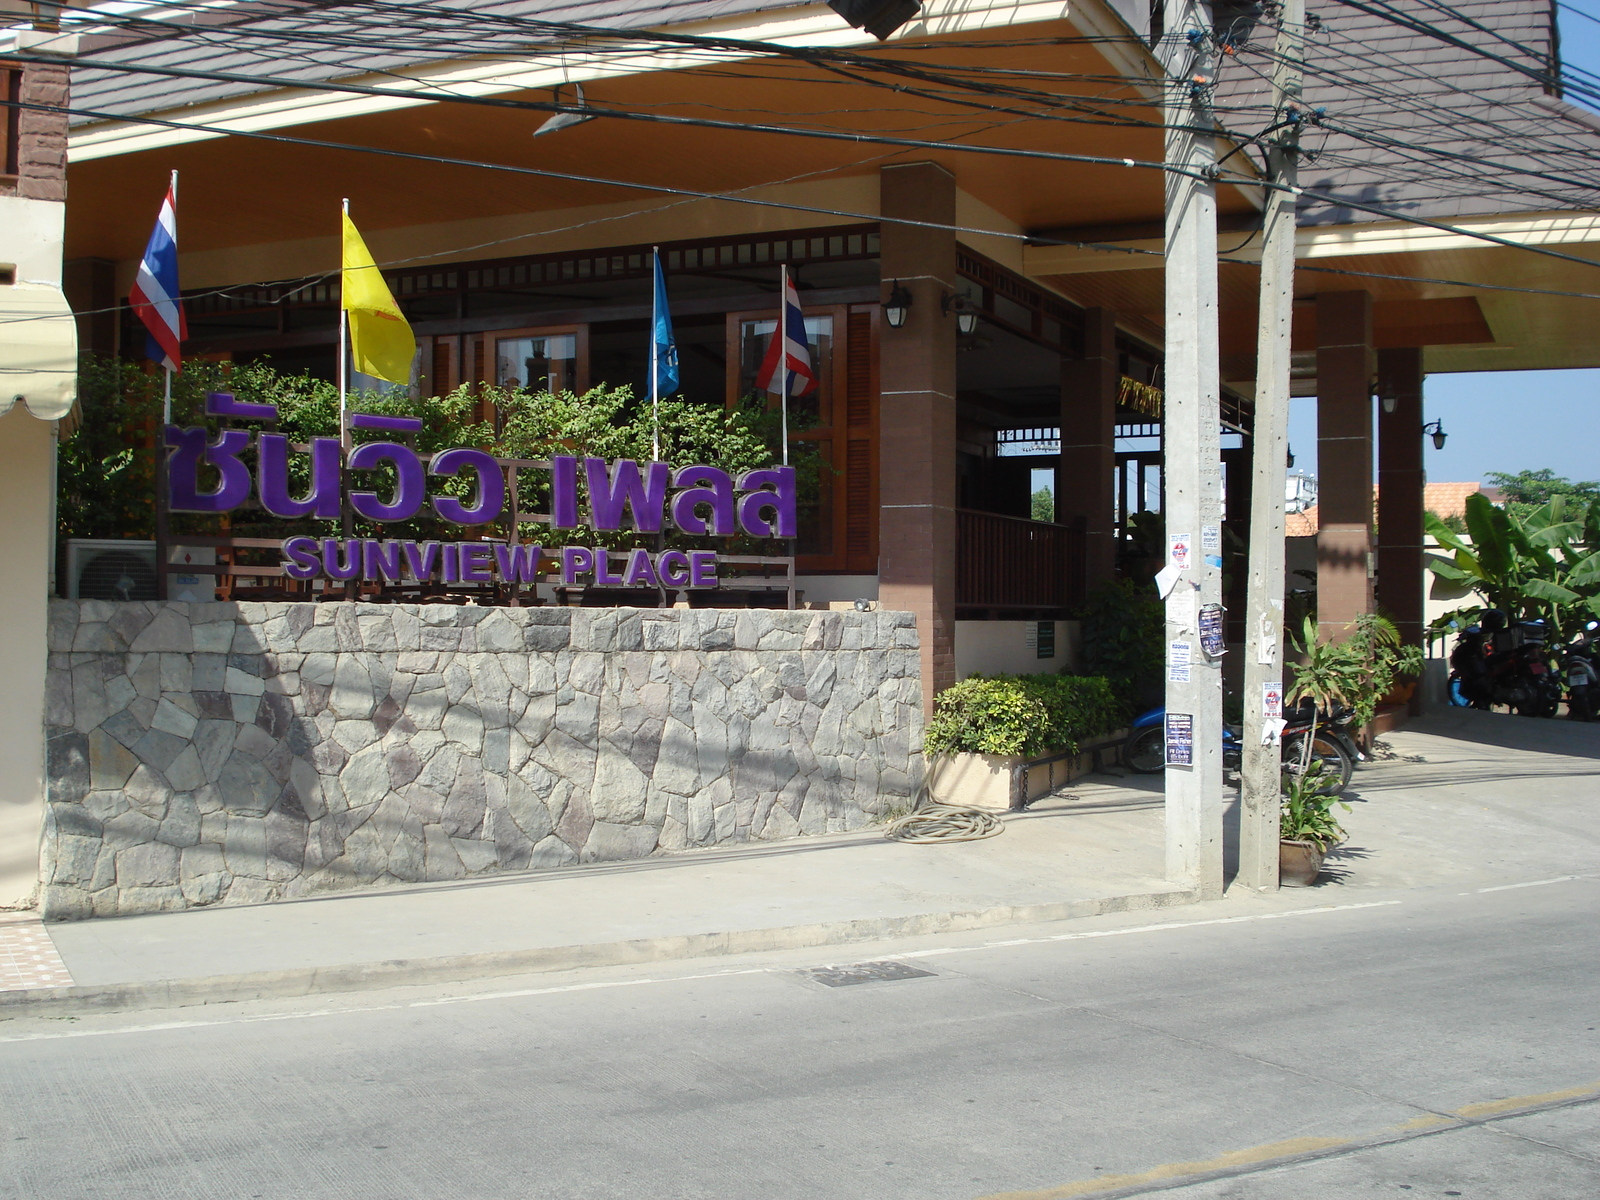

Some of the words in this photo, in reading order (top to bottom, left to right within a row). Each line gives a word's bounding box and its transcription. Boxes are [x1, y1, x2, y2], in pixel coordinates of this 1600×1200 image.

[550, 453, 797, 538] เพลส
[282, 537, 541, 583] SUNVIEW
[560, 546, 718, 587] PLACE
